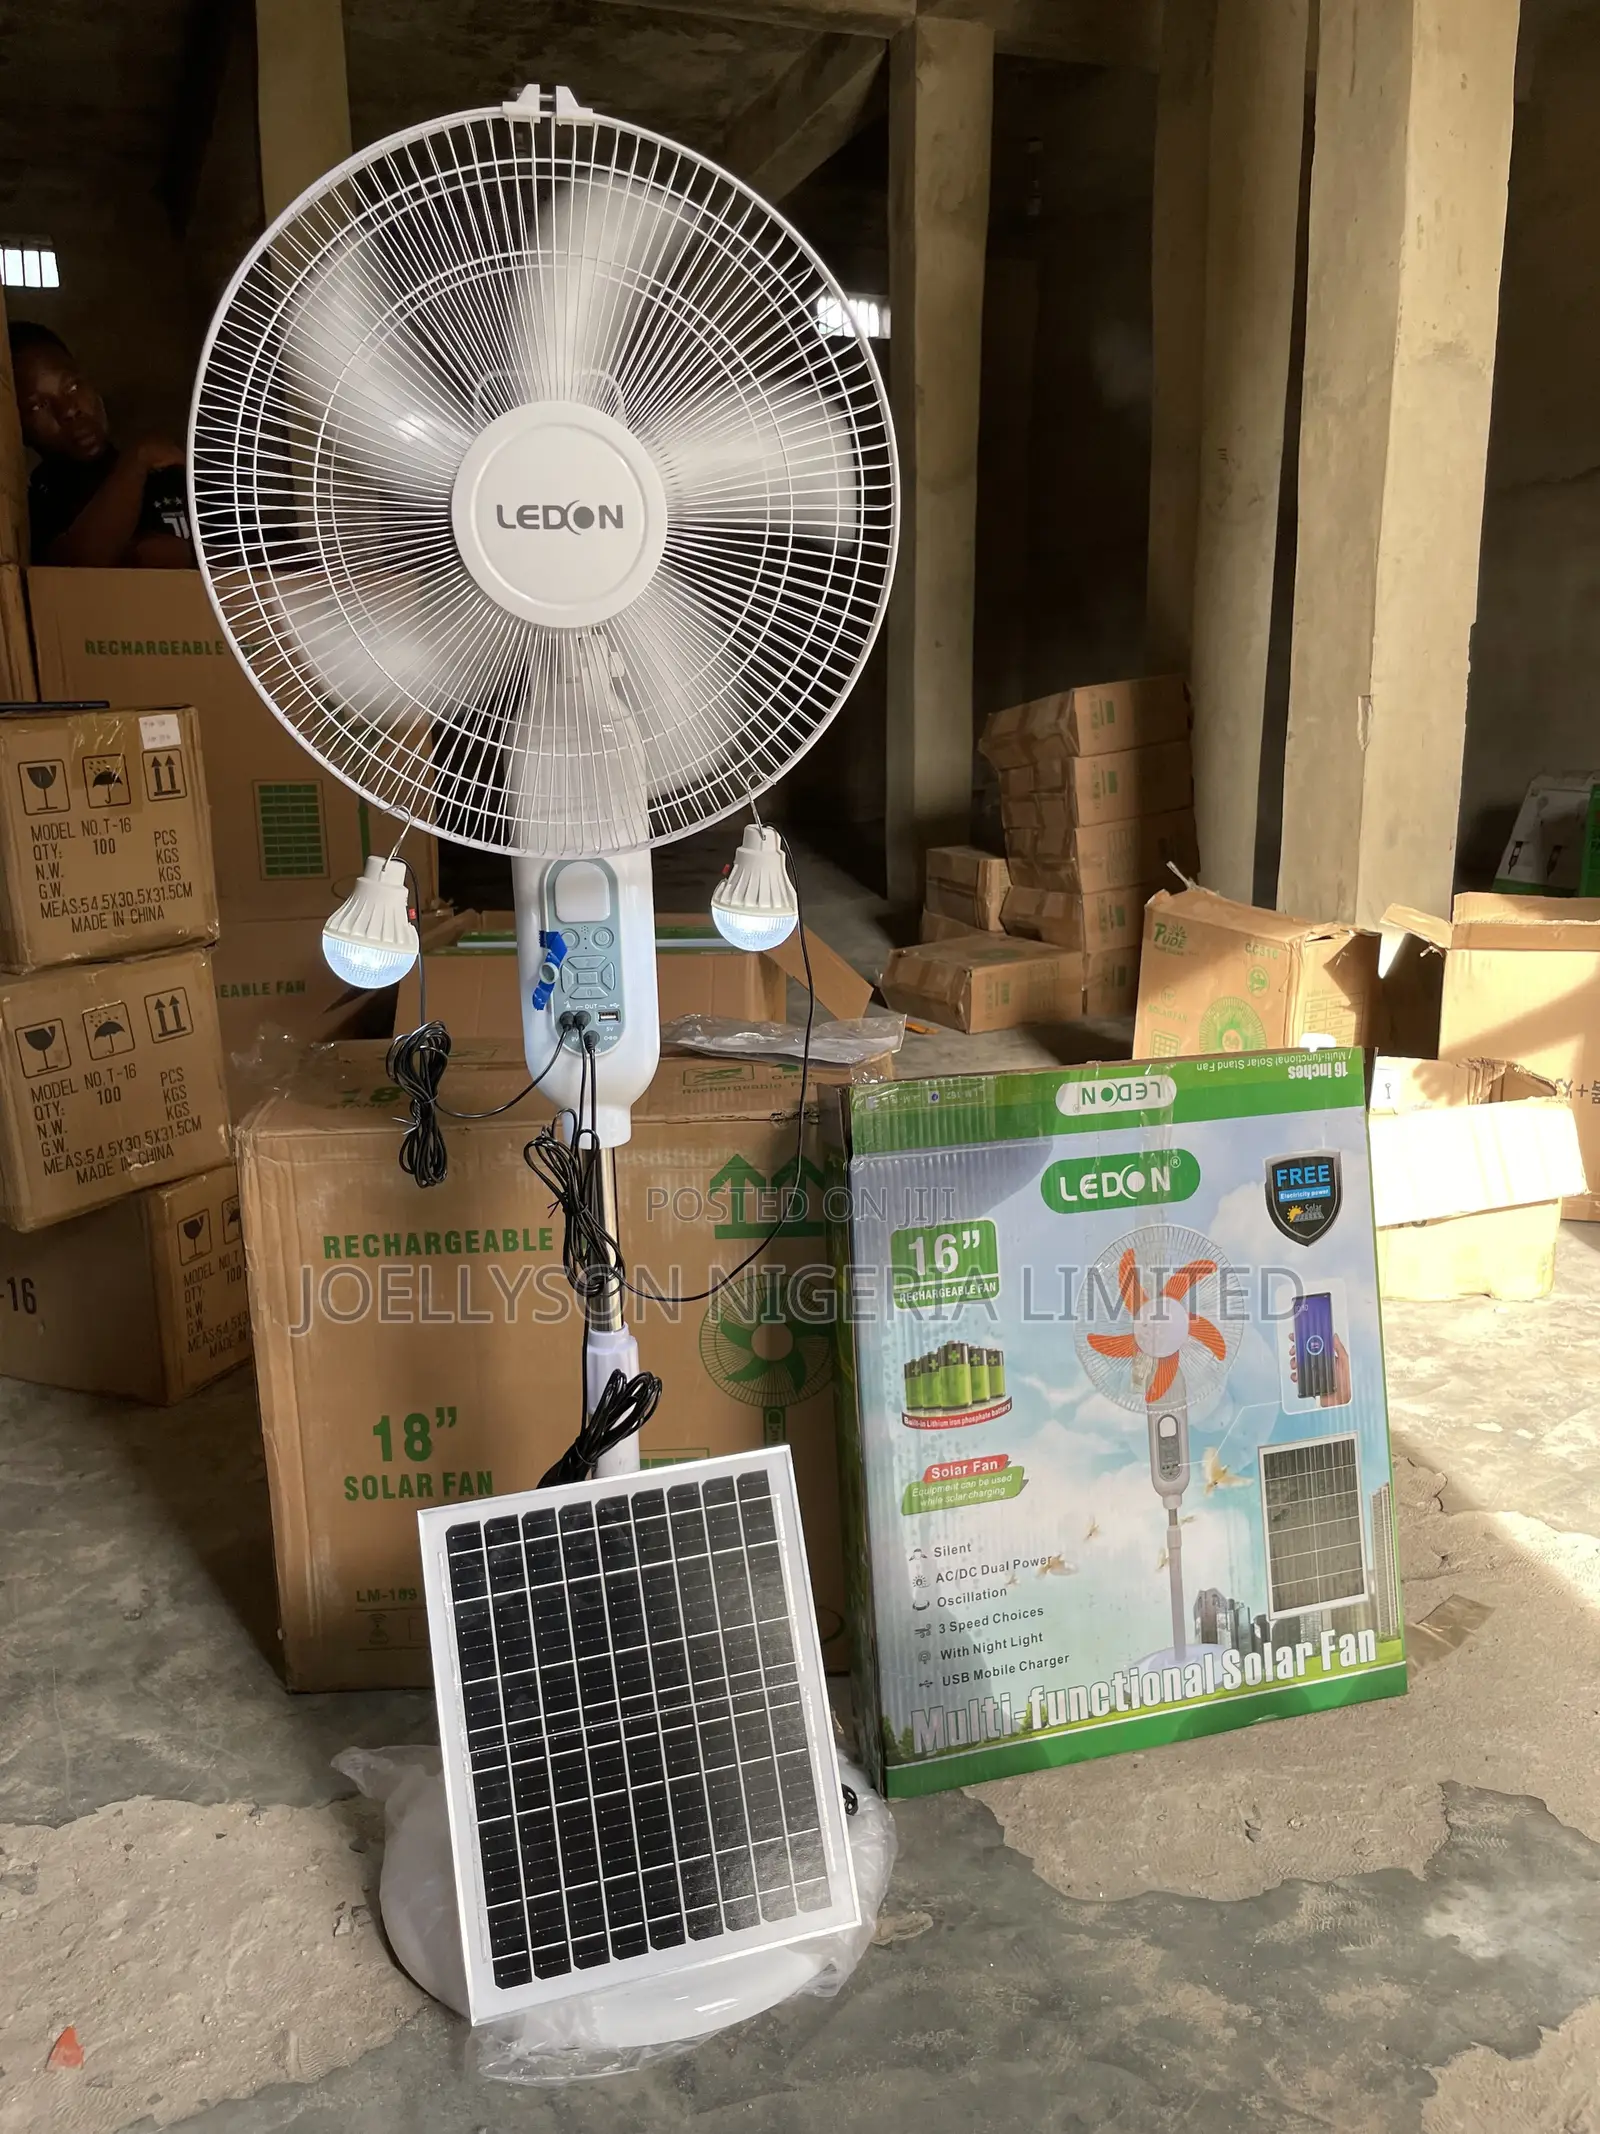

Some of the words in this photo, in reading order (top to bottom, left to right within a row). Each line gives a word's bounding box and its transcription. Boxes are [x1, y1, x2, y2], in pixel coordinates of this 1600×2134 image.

[496, 499, 623, 535] LEDON
[85, 639, 224, 656] RECHARGEABLE
[30, 820, 76, 842] MODEL
[33, 843, 63, 861] QTY:
[93, 838, 116, 855] 100
[154, 829, 177, 848] PCS
[35, 862, 65, 881] N.W.
[155, 847, 180, 865] KGS
[38, 881, 65, 900] G.W.
[158, 865, 182, 883] KGS
[71, 912, 108, 934] MADE
[113, 910, 125, 927] IN
[130, 905, 165, 925] CHINA
[215, 981, 271, 999] EABLE
[277, 980, 306, 995] FAN
[1196, 1063, 1216, 1073] Fan
[1217, 1060, 1245, 1071] Stand
[1247, 1057, 1274, 1068] Solar
[1275, 1051, 1346, 1066] Multi-functional
[1287, 1062, 1333, 1080] inches
[1334, 1061, 1349, 1078] 16
[30, 1078, 79, 1103] MODEL
[34, 1101, 66, 1121] QTY:
[97, 1086, 121, 1106] 100
[160, 1067, 185, 1087] PCS
[1081, 1081, 1162, 1107] LEDON
[37, 1119, 68, 1141] N.W.
[163, 1084, 187, 1105] KGS
[41, 1138, 70, 1158] G.W.
[165, 1102, 190, 1121] KGS
[76, 1160, 116, 1185] MADE
[121, 1155, 133, 1172] IN
[139, 1143, 175, 1167] CHINA
[1276, 1164, 1331, 1187] FREE
[1059, 1164, 1171, 1201] LEDON
[1280, 1191, 1310, 1200] Electricity
[1311, 1189, 1329, 1198] power
[1305, 1203, 1322, 1211] Solar
[323, 1227, 553, 1260] RECHARGEABLE
[226, 1265, 242, 1284] 100
[900, 1284, 977, 1303] RECHARGEABLE
[978, 1281, 997, 1293] FAN
[926, 1419, 949, 1428] Lithium
[949, 1418, 961, 1427] iron
[961, 1411, 991, 1426] phosphate
[991, 1402, 1011, 1417] battery
[931, 1464, 968, 1479] Solar
[973, 1460, 998, 1473] Fan
[344, 1473, 434, 1501] SOLAR
[442, 1471, 494, 1497] FAN
[912, 1481, 959, 1498] Equipment
[960, 1480, 977, 1489] can
[979, 1476, 989, 1486] be
[991, 1473, 1013, 1484] used
[920, 1495, 943, 1507] while
[945, 1491, 968, 1503] solar
[968, 1486, 1006, 1500] charging
[933, 1543, 972, 1558] Silent
[936, 1566, 978, 1584] AC/DC
[981, 1561, 1010, 1576] Dual
[1013, 1555, 1053, 1571] Power
[937, 1587, 1008, 1608] Oscillation
[938, 1623, 946, 1635] 3
[949, 1615, 990, 1634] Speed
[992, 1607, 1045, 1624] Choices
[940, 1646, 971, 1661] With
[973, 1639, 1007, 1655] Night
[1010, 1632, 1044, 1648] Light
[942, 1671, 970, 1687] USB
[973, 1664, 1016, 1681] Mobile
[1019, 1654, 1070, 1673] Charger
[911, 1652, 1215, 1756] Multi-functional
[1222, 1640, 1314, 1691] Solar
[1321, 1628, 1378, 1672] Fan
